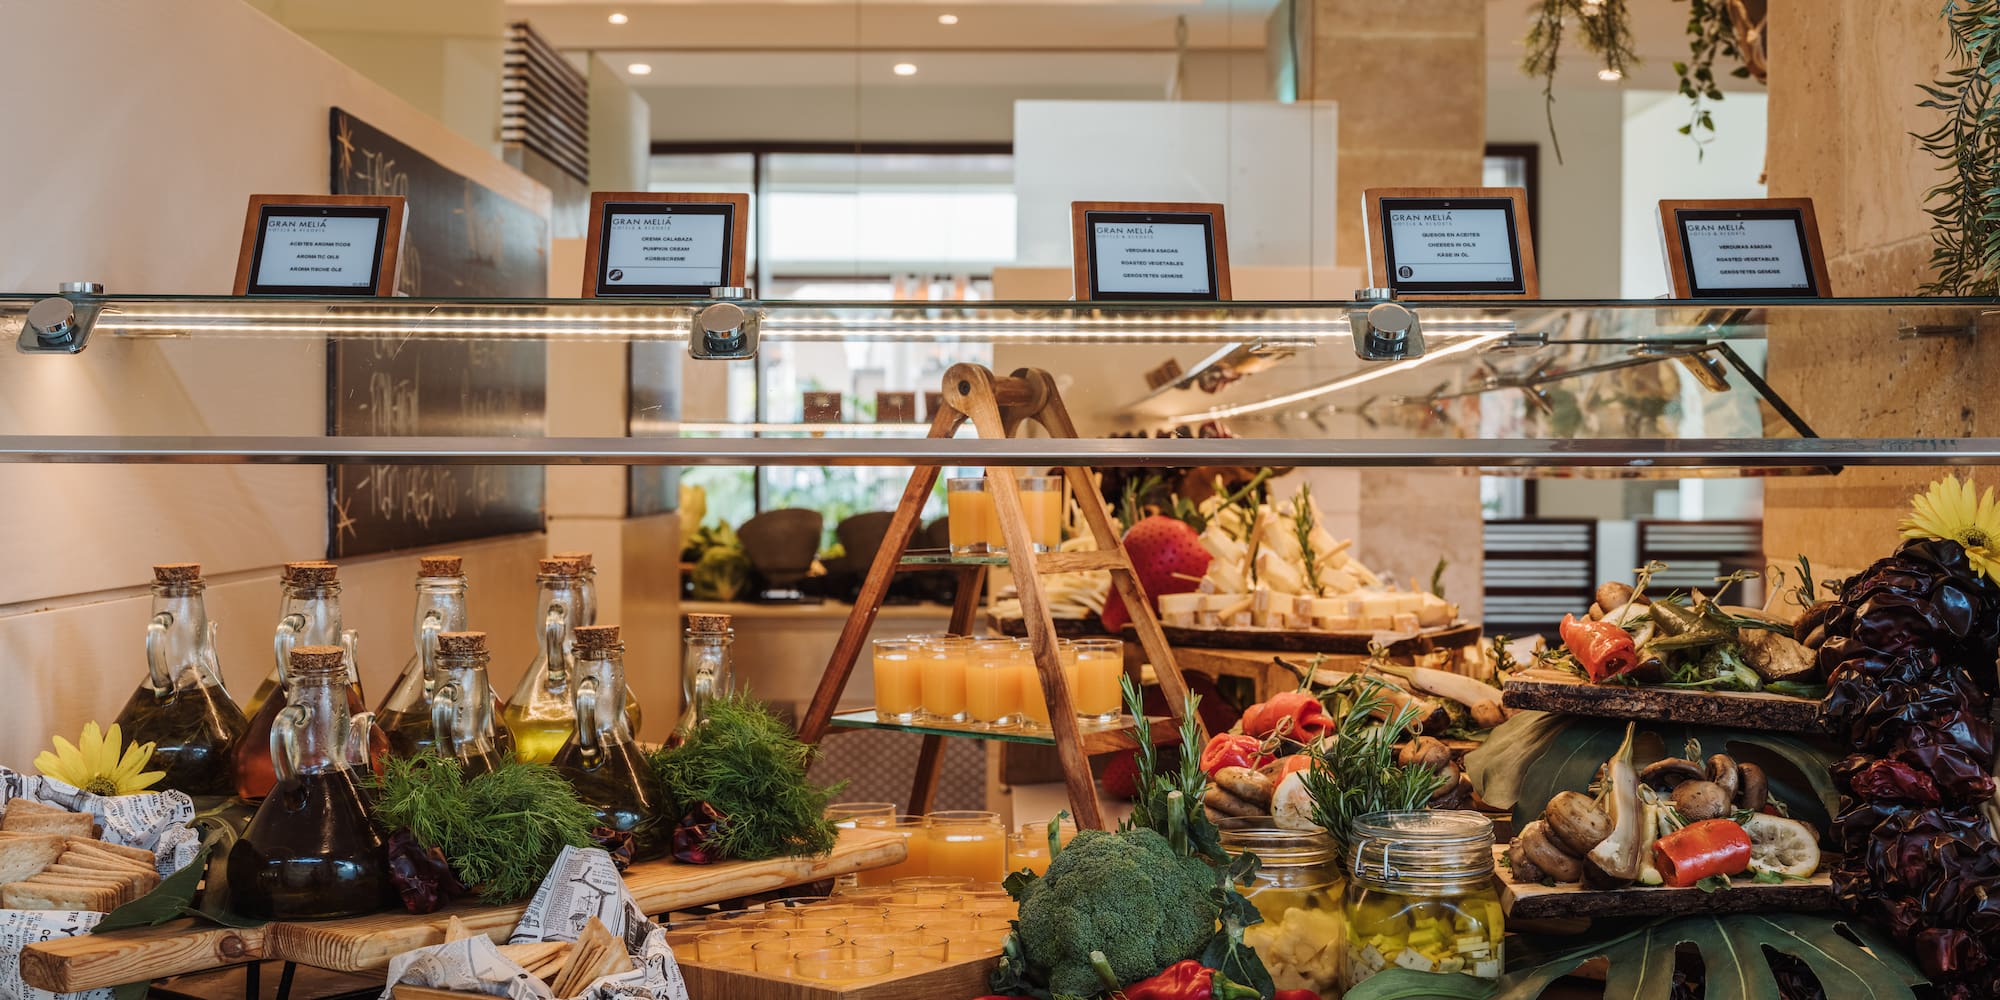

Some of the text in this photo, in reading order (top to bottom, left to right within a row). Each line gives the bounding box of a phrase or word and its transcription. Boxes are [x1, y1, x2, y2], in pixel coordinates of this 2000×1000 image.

[612, 216, 672, 226] GRAN MELIÁ
[1391, 211, 1453, 222] GRAN MELIÁ
[268, 219, 327, 228] GRAN MELIÁ
[1687, 222, 1745, 232] GRAN MELIÁ
[1096, 225, 1154, 235] GRAN MELIÁ
[1421, 231, 1446, 239] QUESOS
[1456, 231, 1481, 239] ACEITES
[67, 911, 79, 923] THE
